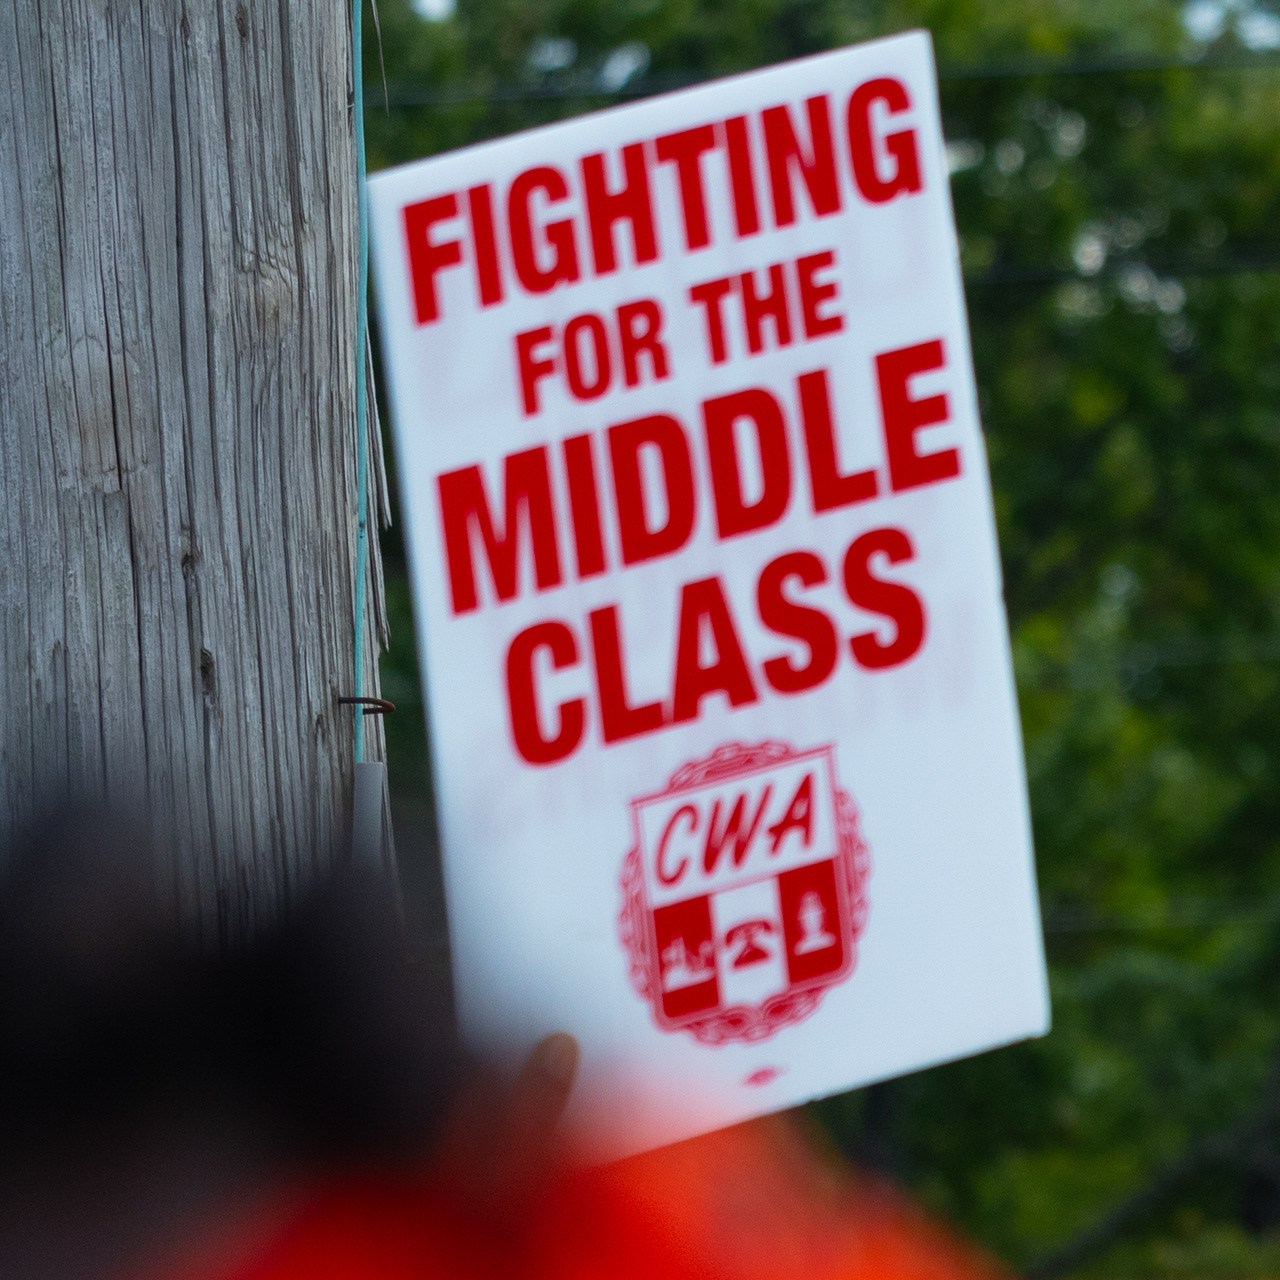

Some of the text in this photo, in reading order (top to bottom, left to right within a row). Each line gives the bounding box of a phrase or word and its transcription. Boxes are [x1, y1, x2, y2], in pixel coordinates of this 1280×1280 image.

[402, 78, 923, 326] FIGHTING
[514, 250, 844, 417] FOR THE
[436, 339, 961, 616] MIDDLE
[505, 527, 927, 767] CLASS
[656, 773, 814, 887] CWA
